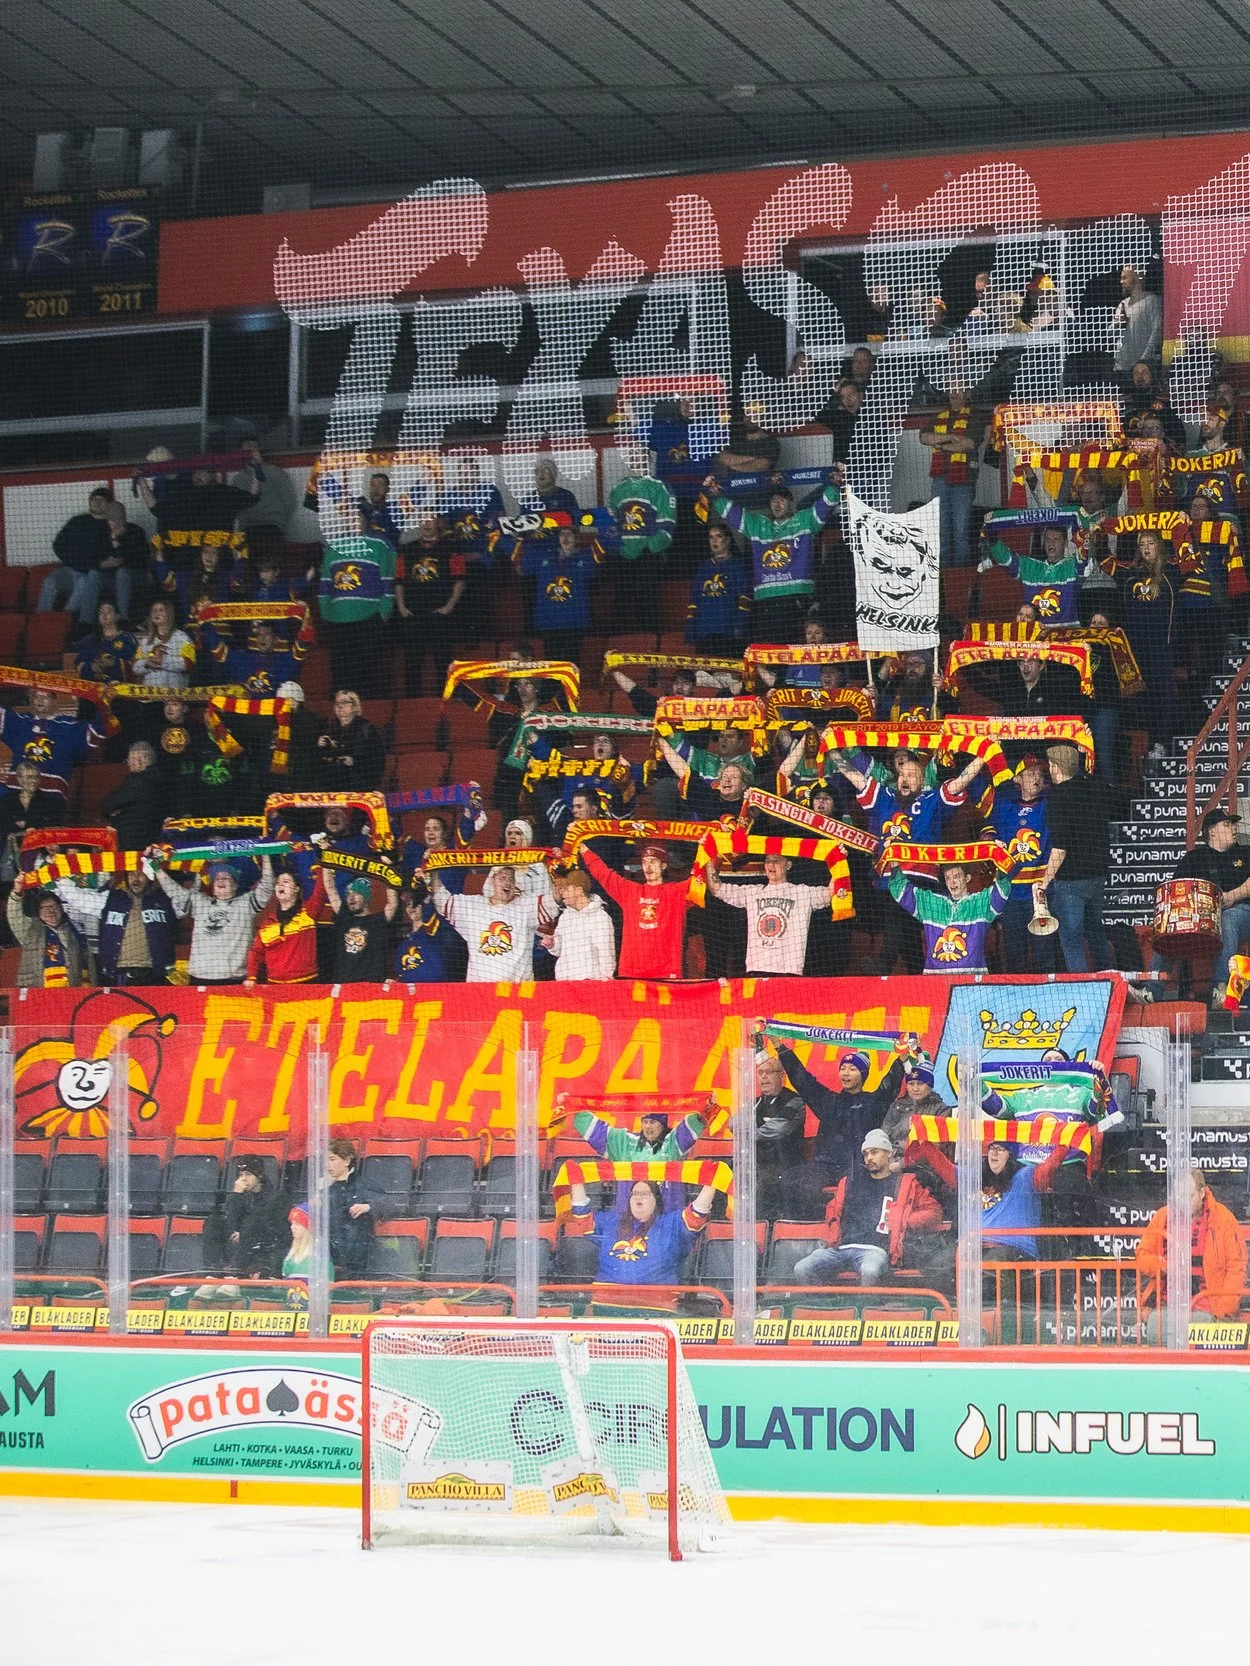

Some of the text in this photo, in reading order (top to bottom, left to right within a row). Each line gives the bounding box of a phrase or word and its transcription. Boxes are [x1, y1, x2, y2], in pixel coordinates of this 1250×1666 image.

[25, 298, 69, 319] 2010
[101, 292, 143, 312] 2011
[856, 604, 940, 635] HELSINKI
[911, 801, 921, 815] C
[818, 813, 881, 852] JOKERIT
[425, 850, 546, 868] JOKERIT HELSINKI
[886, 843, 995, 861] JOKERIT
[755, 897, 797, 918] JOKERIT
[805, 1026, 857, 1042] JOKERIT
[177, 980, 933, 1139] ETELÄPÄÄTY
[1000, 1065, 1053, 1081] JOKERIT
[159, 1381, 261, 1440] pata
[586, 1400, 915, 1453] CIRULATION
[1016, 1410, 1216, 1455] INFUEL
[213, 1443, 353, 1456] LAHTI KOTKA VAASA TURKU
[192, 1456, 234, 1468] HELSINKI
[239, 1456, 283, 1468] TAMPERE
[288, 1456, 342, 1471] JYVÄSKYLÄ
[410, 1484, 503, 1497] PANCHO VILLA
